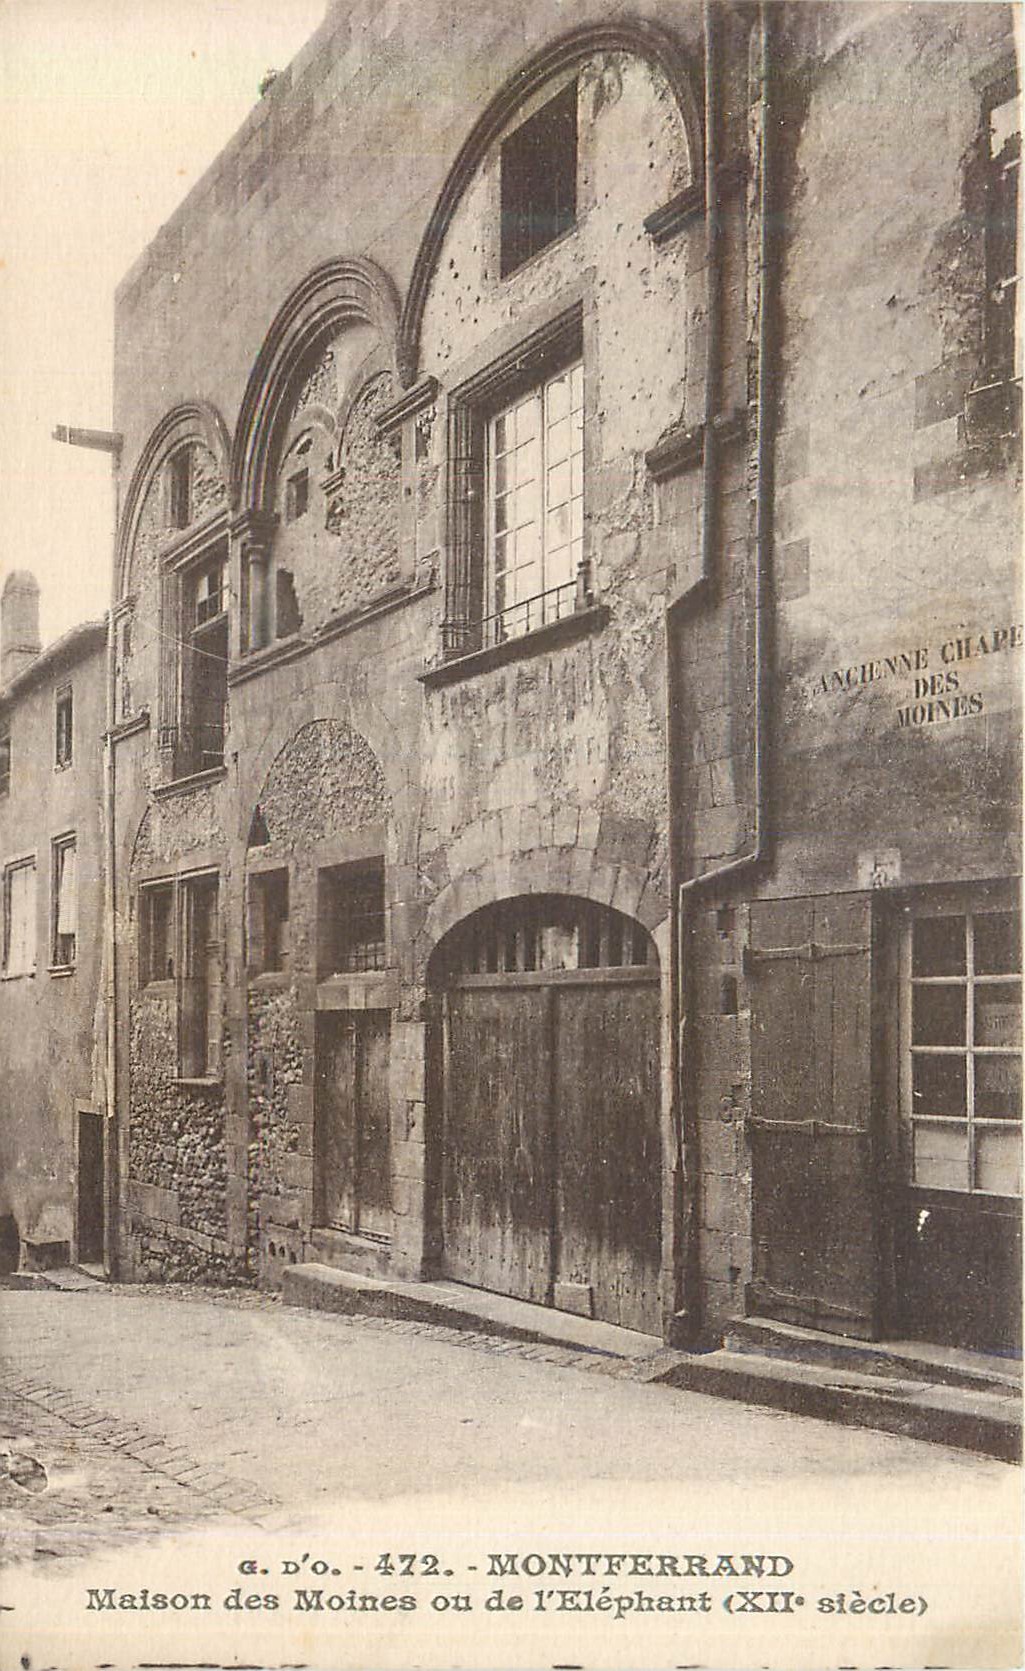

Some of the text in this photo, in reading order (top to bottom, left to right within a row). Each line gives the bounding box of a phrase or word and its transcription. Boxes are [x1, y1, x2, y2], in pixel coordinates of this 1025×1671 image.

[812, 648, 929, 697] ANCIENNE
[914, 670, 960, 699] DES
[897, 692, 984, 728] MOINES
